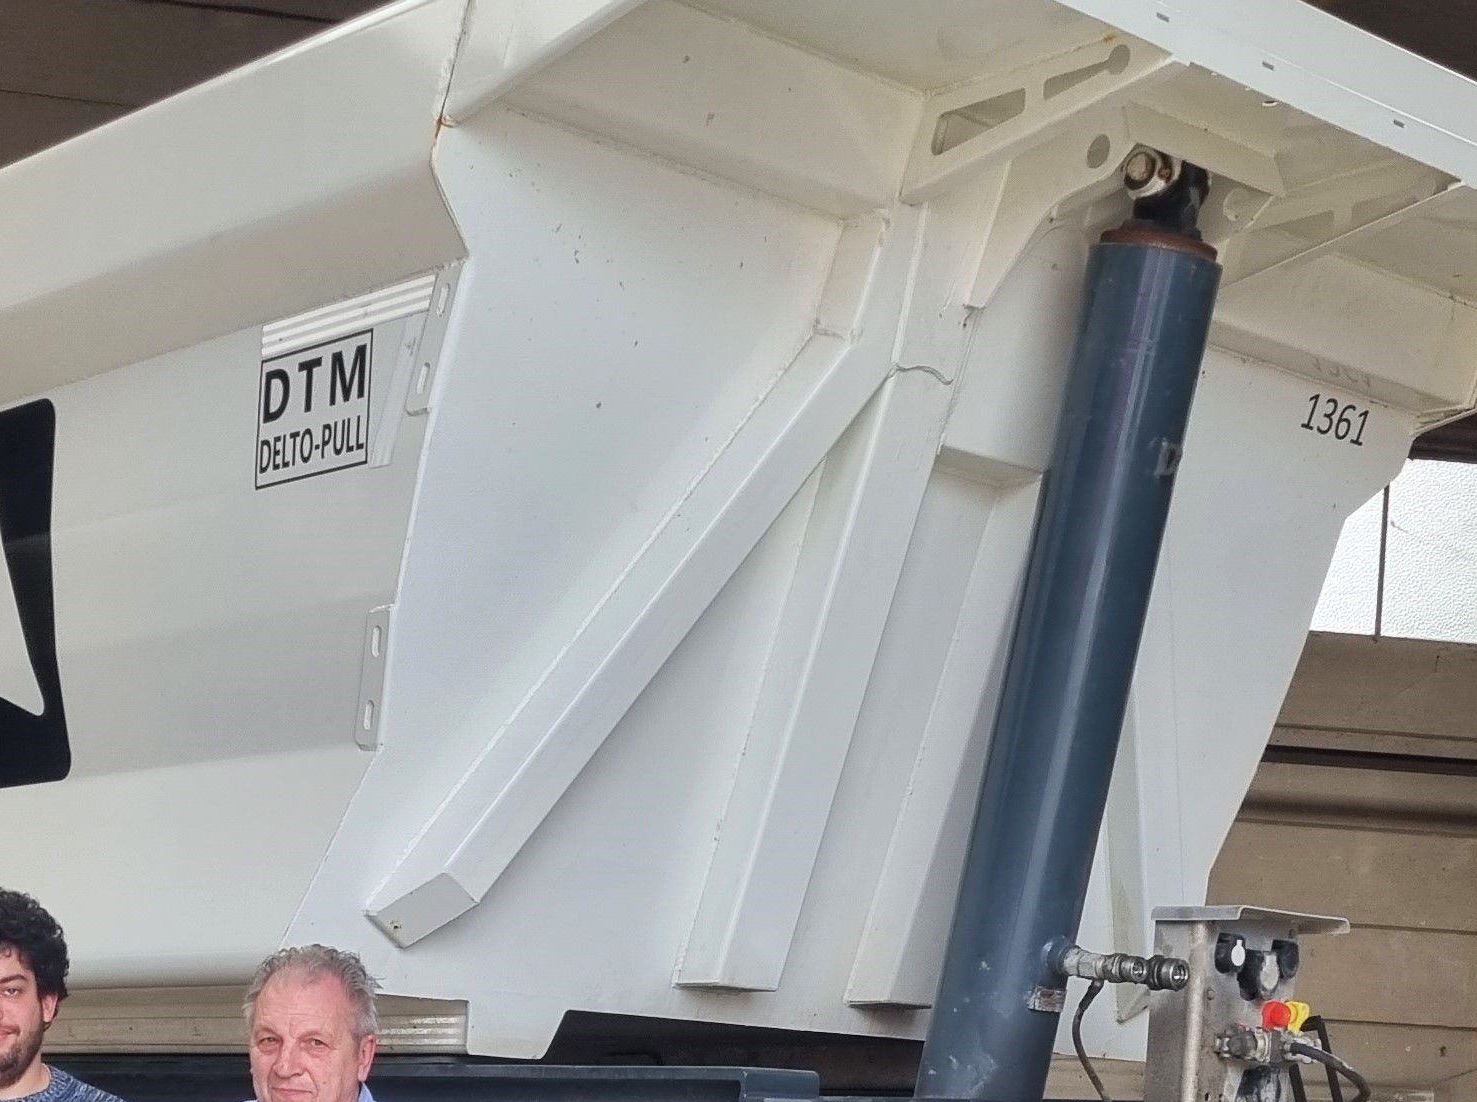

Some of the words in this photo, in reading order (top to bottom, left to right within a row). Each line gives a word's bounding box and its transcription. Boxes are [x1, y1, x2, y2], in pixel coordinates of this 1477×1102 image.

[263, 344, 367, 424] DTM
[259, 415, 364, 474] DELTO-PULL
[1300, 393, 1370, 447] 1361
